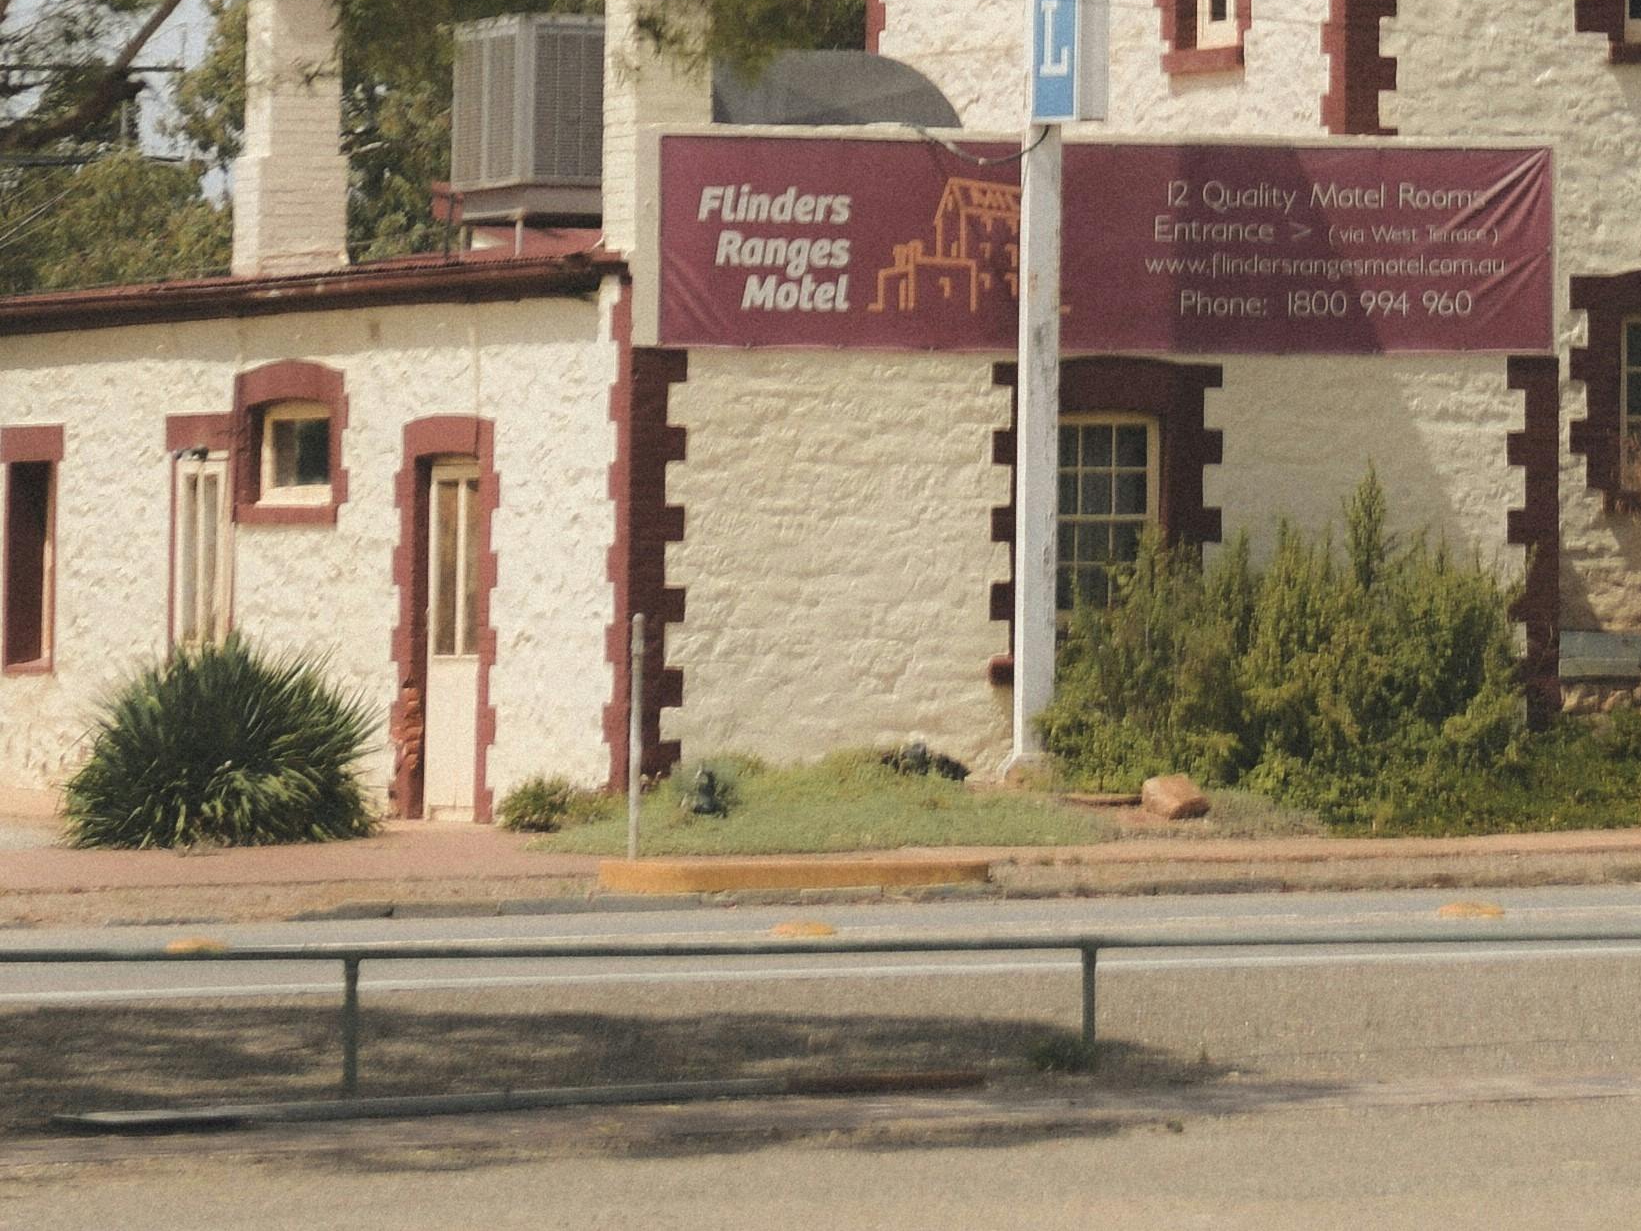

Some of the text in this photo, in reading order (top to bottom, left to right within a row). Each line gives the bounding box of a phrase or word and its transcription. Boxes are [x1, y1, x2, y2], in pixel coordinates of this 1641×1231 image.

[697, 183, 852, 225] Flinders
[1166, 180, 1486, 215] 12 Quality Motel Rooms
[1153, 216, 1275, 243] Entrance
[1372, 226, 1417, 243] West
[714, 230, 852, 278] Ranges
[1145, 252, 1506, 281] www.flindersrangesmotel.com.au
[740, 273, 850, 313] Motel
[1179, 290, 1473, 318] Phone: 1800 994 960
